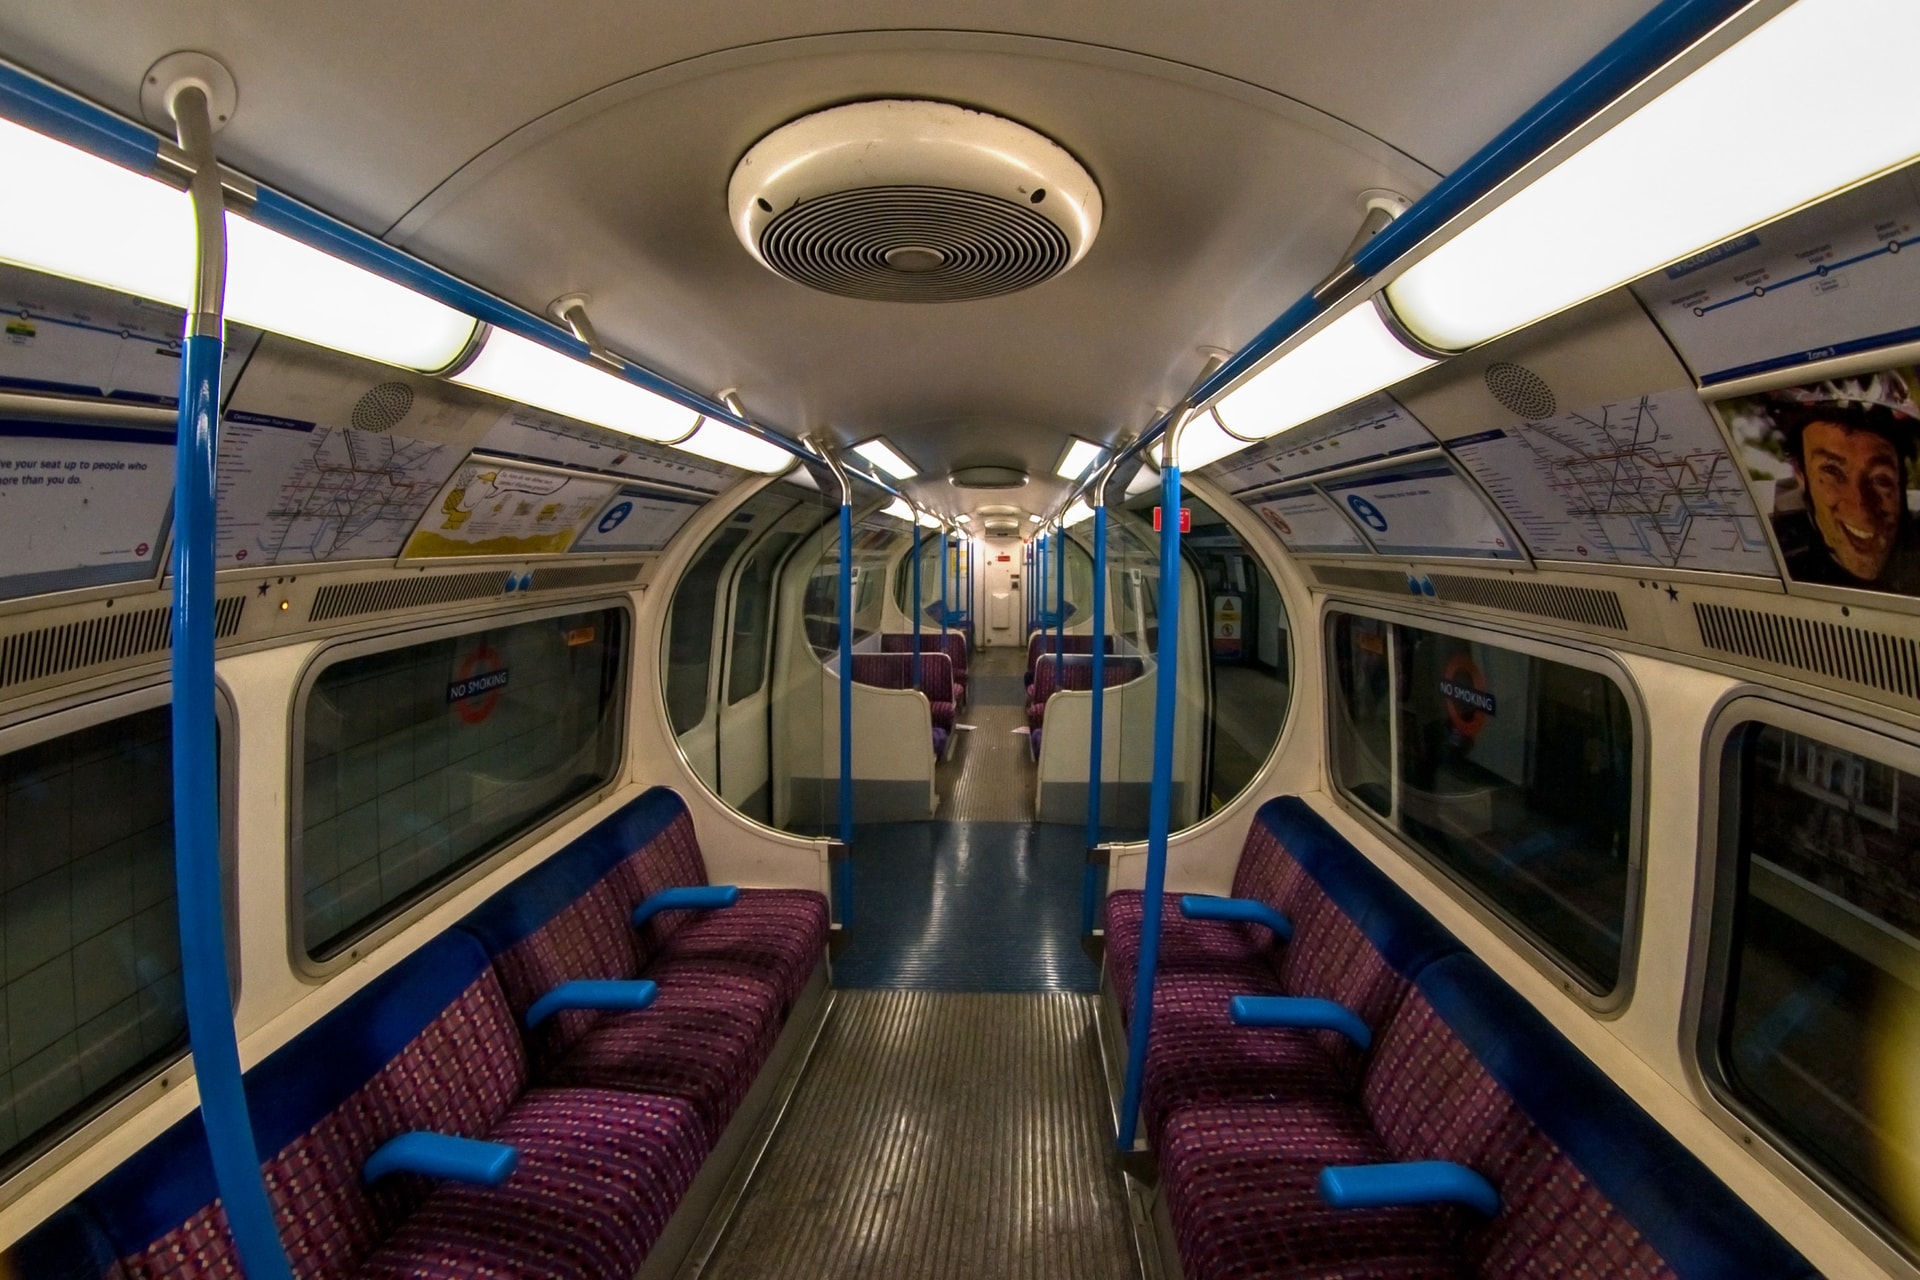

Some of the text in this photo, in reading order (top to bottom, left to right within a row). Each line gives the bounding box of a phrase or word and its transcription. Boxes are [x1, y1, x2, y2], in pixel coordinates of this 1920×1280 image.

[1807, 350, 1829, 361] Zone
[14, 461, 38, 470] your
[40, 461, 61, 469] seat
[64, 461, 77, 470] up
[79, 461, 90, 470] to
[92, 461, 125, 471] people
[127, 461, 148, 471] who
[22, 475, 44, 484] than
[47, 476, 65, 486] you
[67, 475, 82, 484] do.
[450, 671, 507, 699] NO SMOKING
[1440, 681, 1493, 711] NO SMOKING
